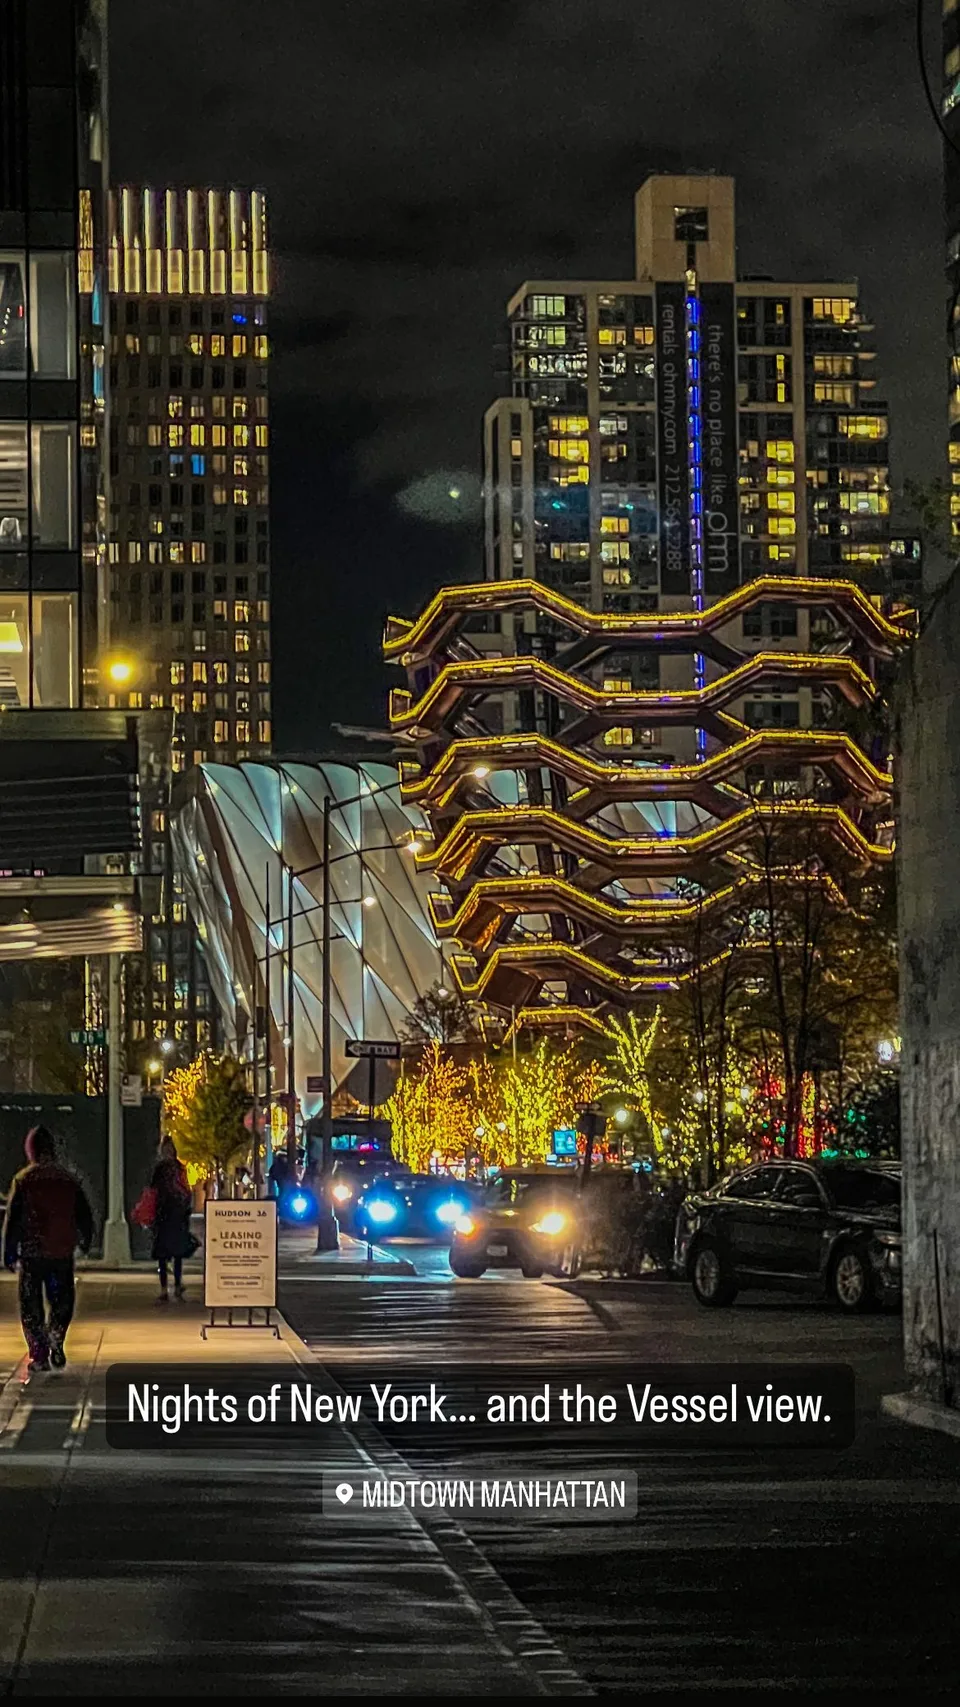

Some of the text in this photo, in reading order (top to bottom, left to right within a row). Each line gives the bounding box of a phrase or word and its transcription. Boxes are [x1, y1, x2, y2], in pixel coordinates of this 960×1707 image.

[662, 304, 680, 355] rentals
[661, 362, 679, 455] ohmny.com
[707, 324, 737, 572] there's no place like ohm
[70, 1031, 81, 1044] W
[220, 1231, 262, 1240] LEASING
[223, 1241, 259, 1249] CENTER
